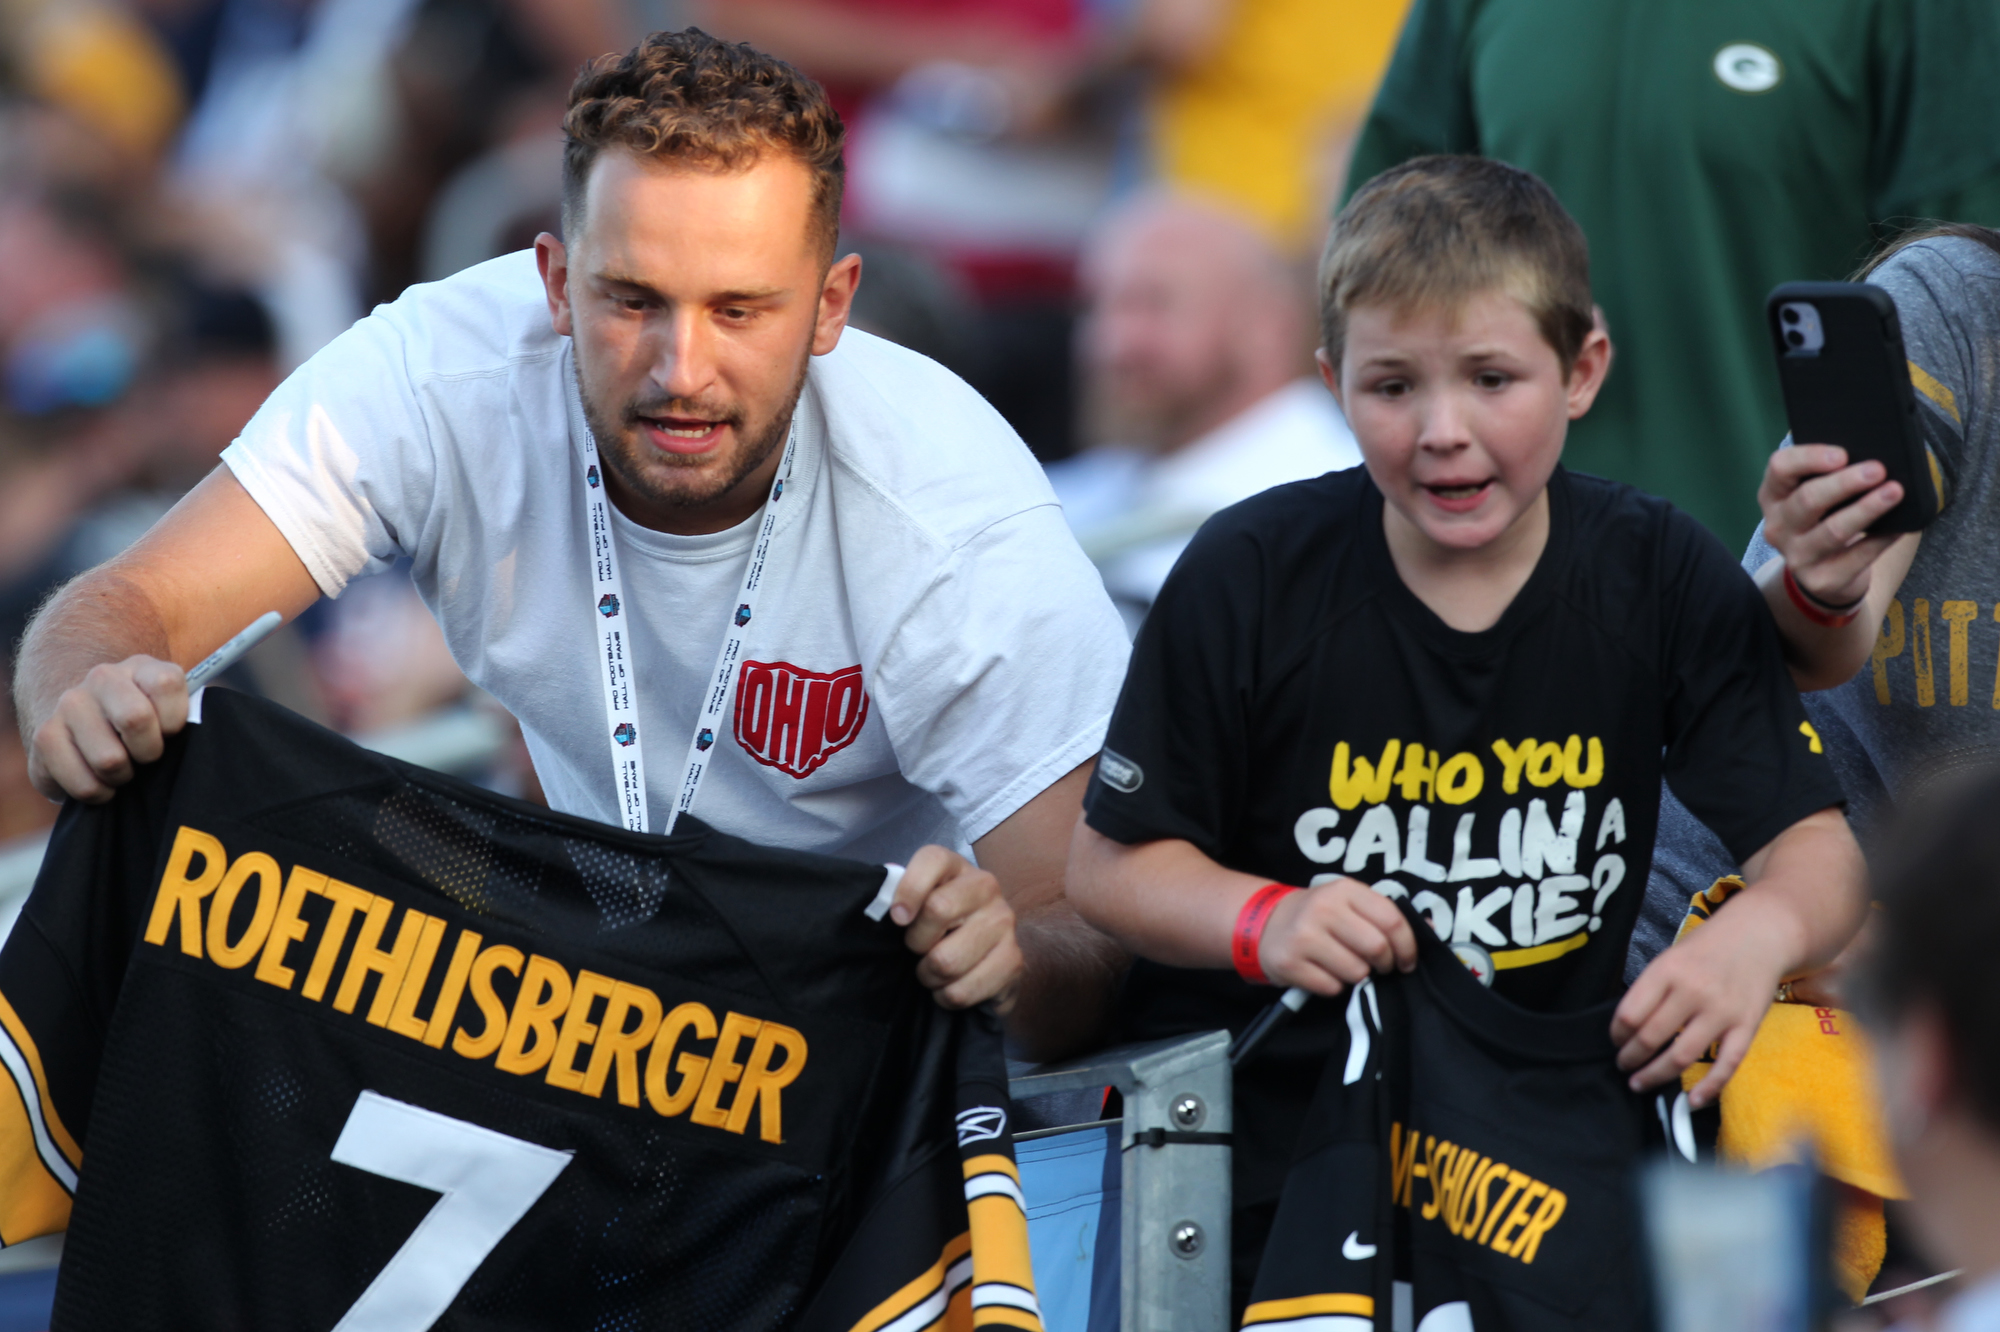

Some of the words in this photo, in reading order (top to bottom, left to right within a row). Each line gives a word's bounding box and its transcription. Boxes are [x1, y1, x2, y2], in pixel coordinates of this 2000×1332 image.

[592, 502, 602, 557] FOOTBALL
[598, 502, 606, 531] FAME
[760, 514, 772, 540] HALL
[768, 515, 776, 536] PRO
[751, 539, 769, 591] FOOTBALL
[756, 544, 763, 558] OF
[597, 562, 605, 582] PRO
[746, 562, 758, 590] FAME
[606, 631, 617, 686] FOOTBALL
[614, 631, 623, 660] FAME
[722, 639, 734, 665] HALL
[731, 640, 741, 661] PRO
[1871, 597, 2000, 710] PIT
[618, 663, 625, 678] OF
[718, 669, 725, 683] OF
[621, 682, 629, 709] HALL
[708, 686, 719, 714] FAME
[714, 664, 733, 715] FOOTBALL
[741, 668, 863, 769] OHIO
[630, 761, 638, 789] FAME
[684, 763, 696, 789] HALL
[692, 764, 702, 785] PRO
[1329, 738, 1484, 810] WHO
[1491, 734, 1604, 794] YOU
[621, 761, 632, 815] FOOTBALL
[634, 792, 641, 807] OF
[680, 793, 687, 807] OF
[1294, 789, 1586, 883] CALLIN
[1595, 797, 1626, 851] A
[144, 826, 808, 1144] ROETHLISBERGER
[330, 1089, 575, 1332] 7
